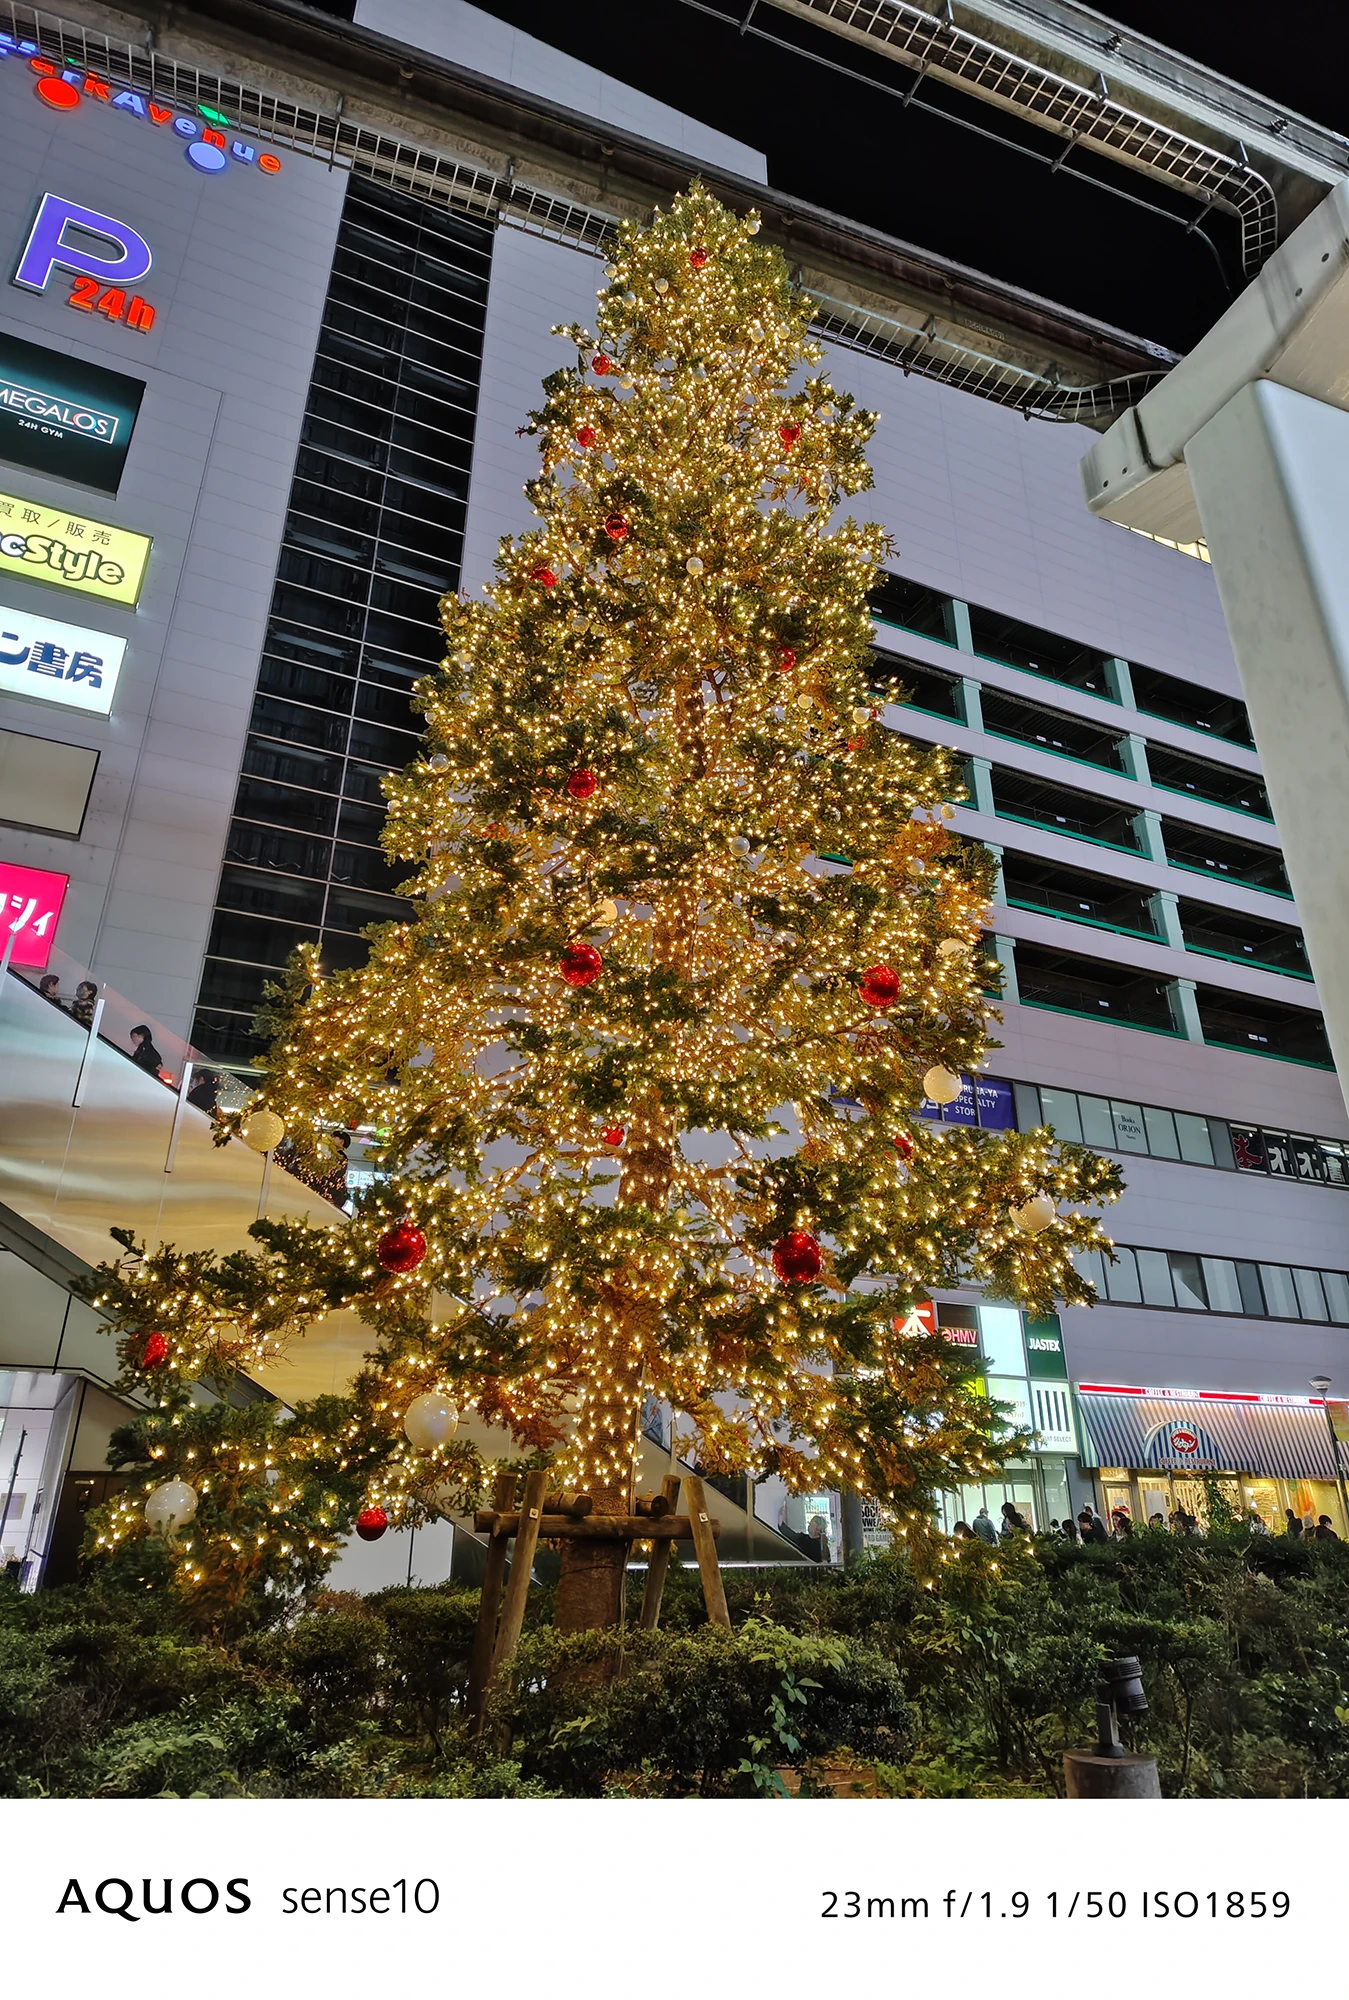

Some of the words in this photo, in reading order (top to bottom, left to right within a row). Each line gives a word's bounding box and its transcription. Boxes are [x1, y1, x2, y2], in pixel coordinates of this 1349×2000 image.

[13, 191, 152, 291] P
[68, 275, 157, 331] 24h
[18, 419, 38, 431] 24H
[41, 427, 63, 439] GYM
[0, 532, 125, 585] cStyle
[1118, 1123, 1141, 1134] ORION
[952, 1330, 977, 1344] HMV
